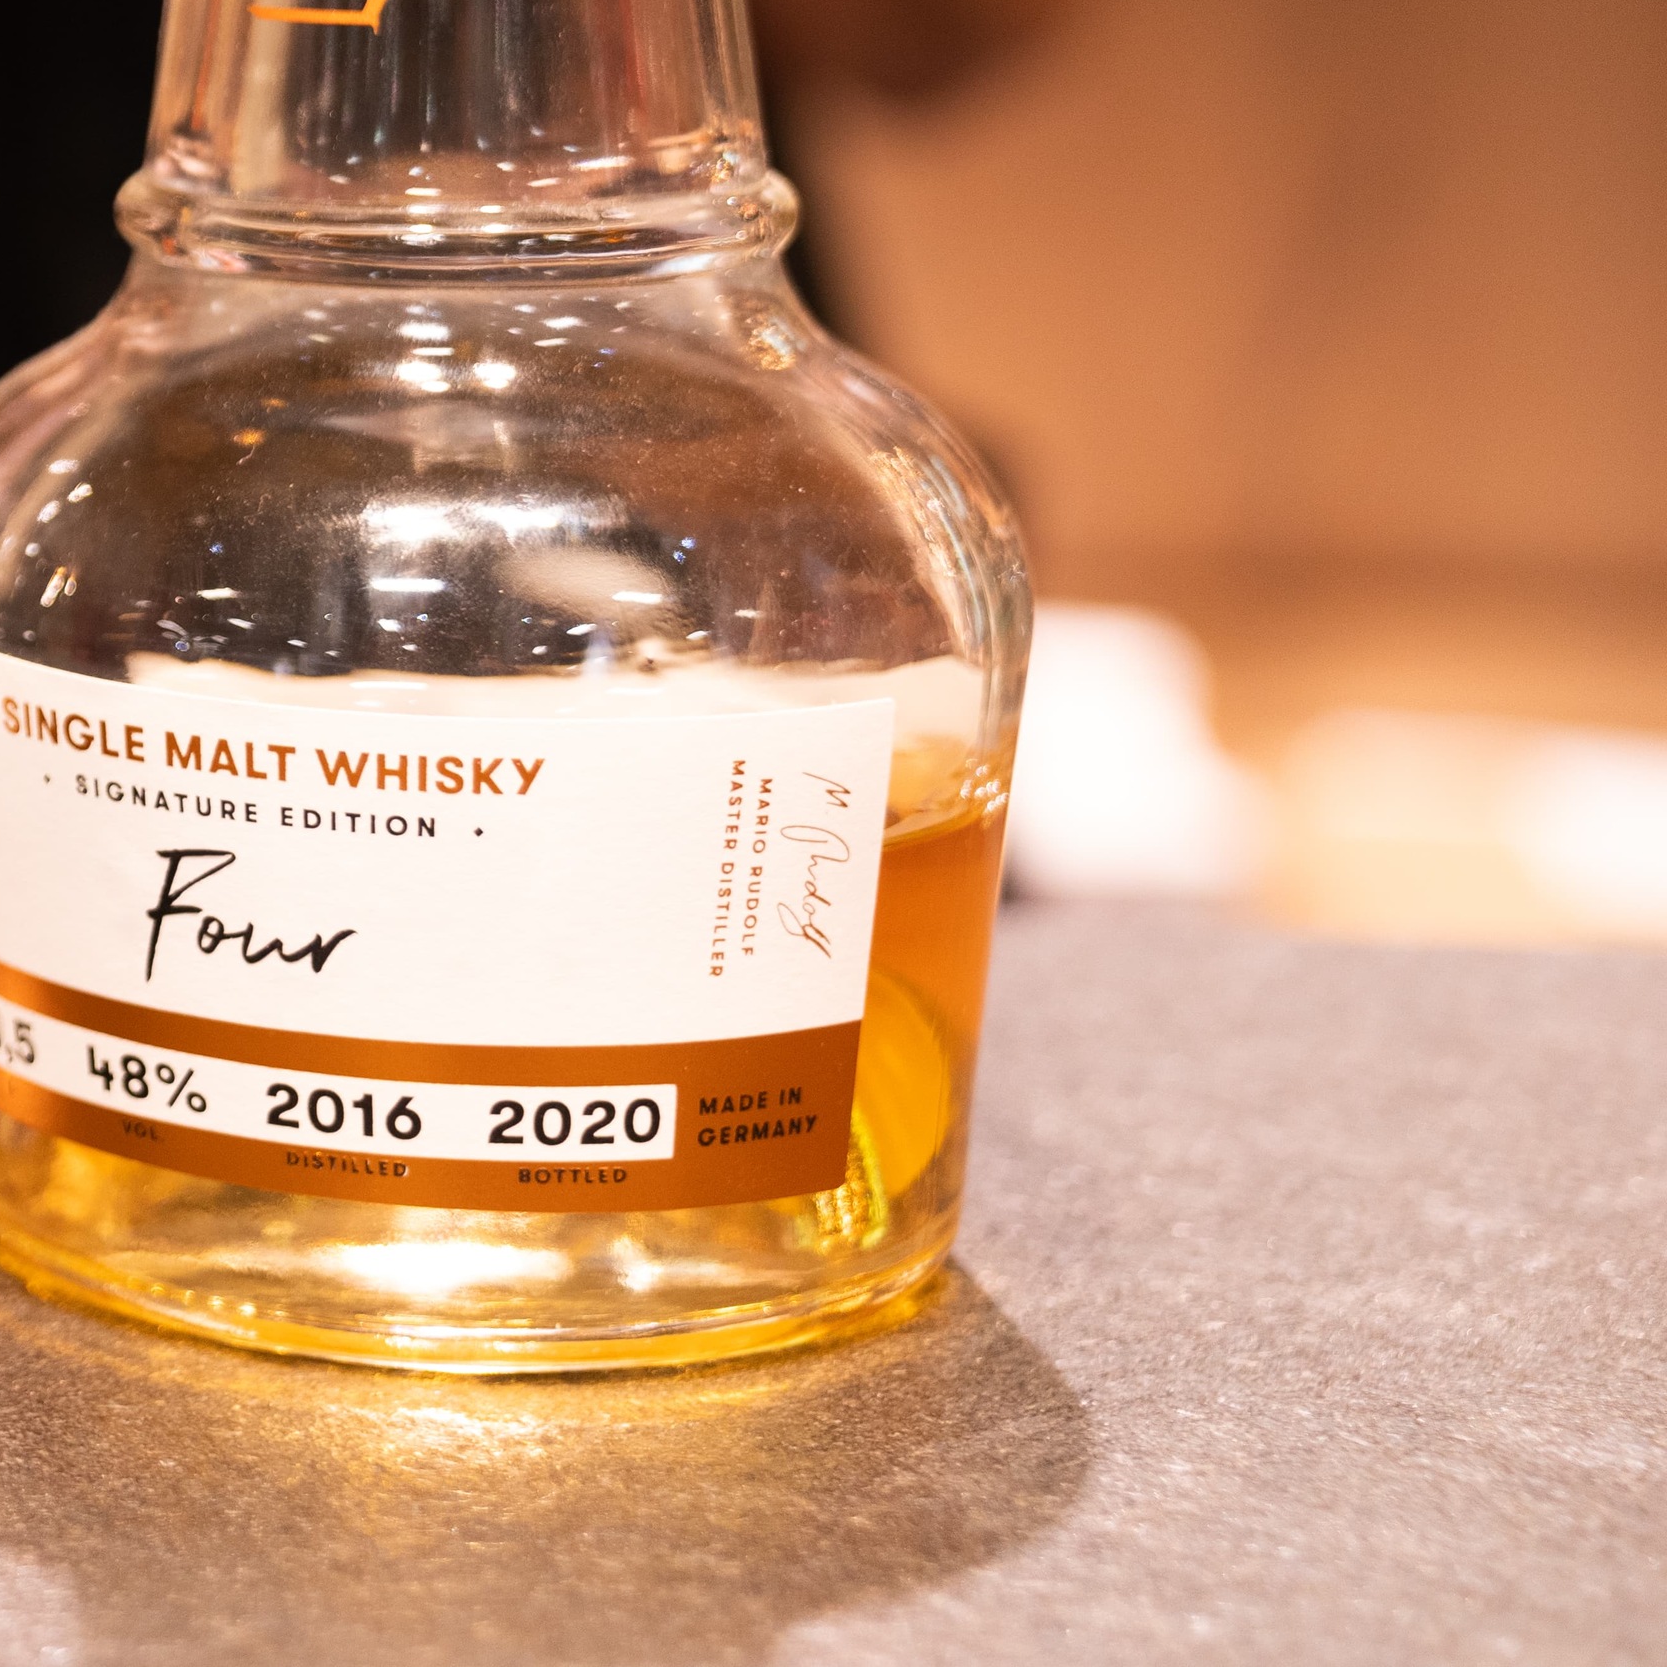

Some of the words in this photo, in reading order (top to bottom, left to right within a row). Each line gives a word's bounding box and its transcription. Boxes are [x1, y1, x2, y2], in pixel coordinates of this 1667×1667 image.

[3, 697, 145, 762] SINGLE
[165, 731, 296, 781] MALT
[316, 749, 544, 795] WHISKY
[75, 773, 259, 823] SIGNATURE
[281, 807, 435, 837] EDITION
[723, 759, 746, 852] MASTER
[752, 777, 774, 855] MARIO
[146, 849, 358, 982] Four
[709, 861, 736, 978] DISTILLER
[741, 865, 764, 957] RUDOLF
[87, 1044, 208, 1114] 48%
[265, 1082, 423, 1141] 2016
[488, 1097, 661, 1147] 2020
[698, 1089, 767, 1115] MADE
[779, 1086, 803, 1106] IN
[698, 1113, 818, 1147] GERMANY
[286, 1151, 408, 1178] DISTILLED
[518, 1167, 627, 1184] BOTTLED
